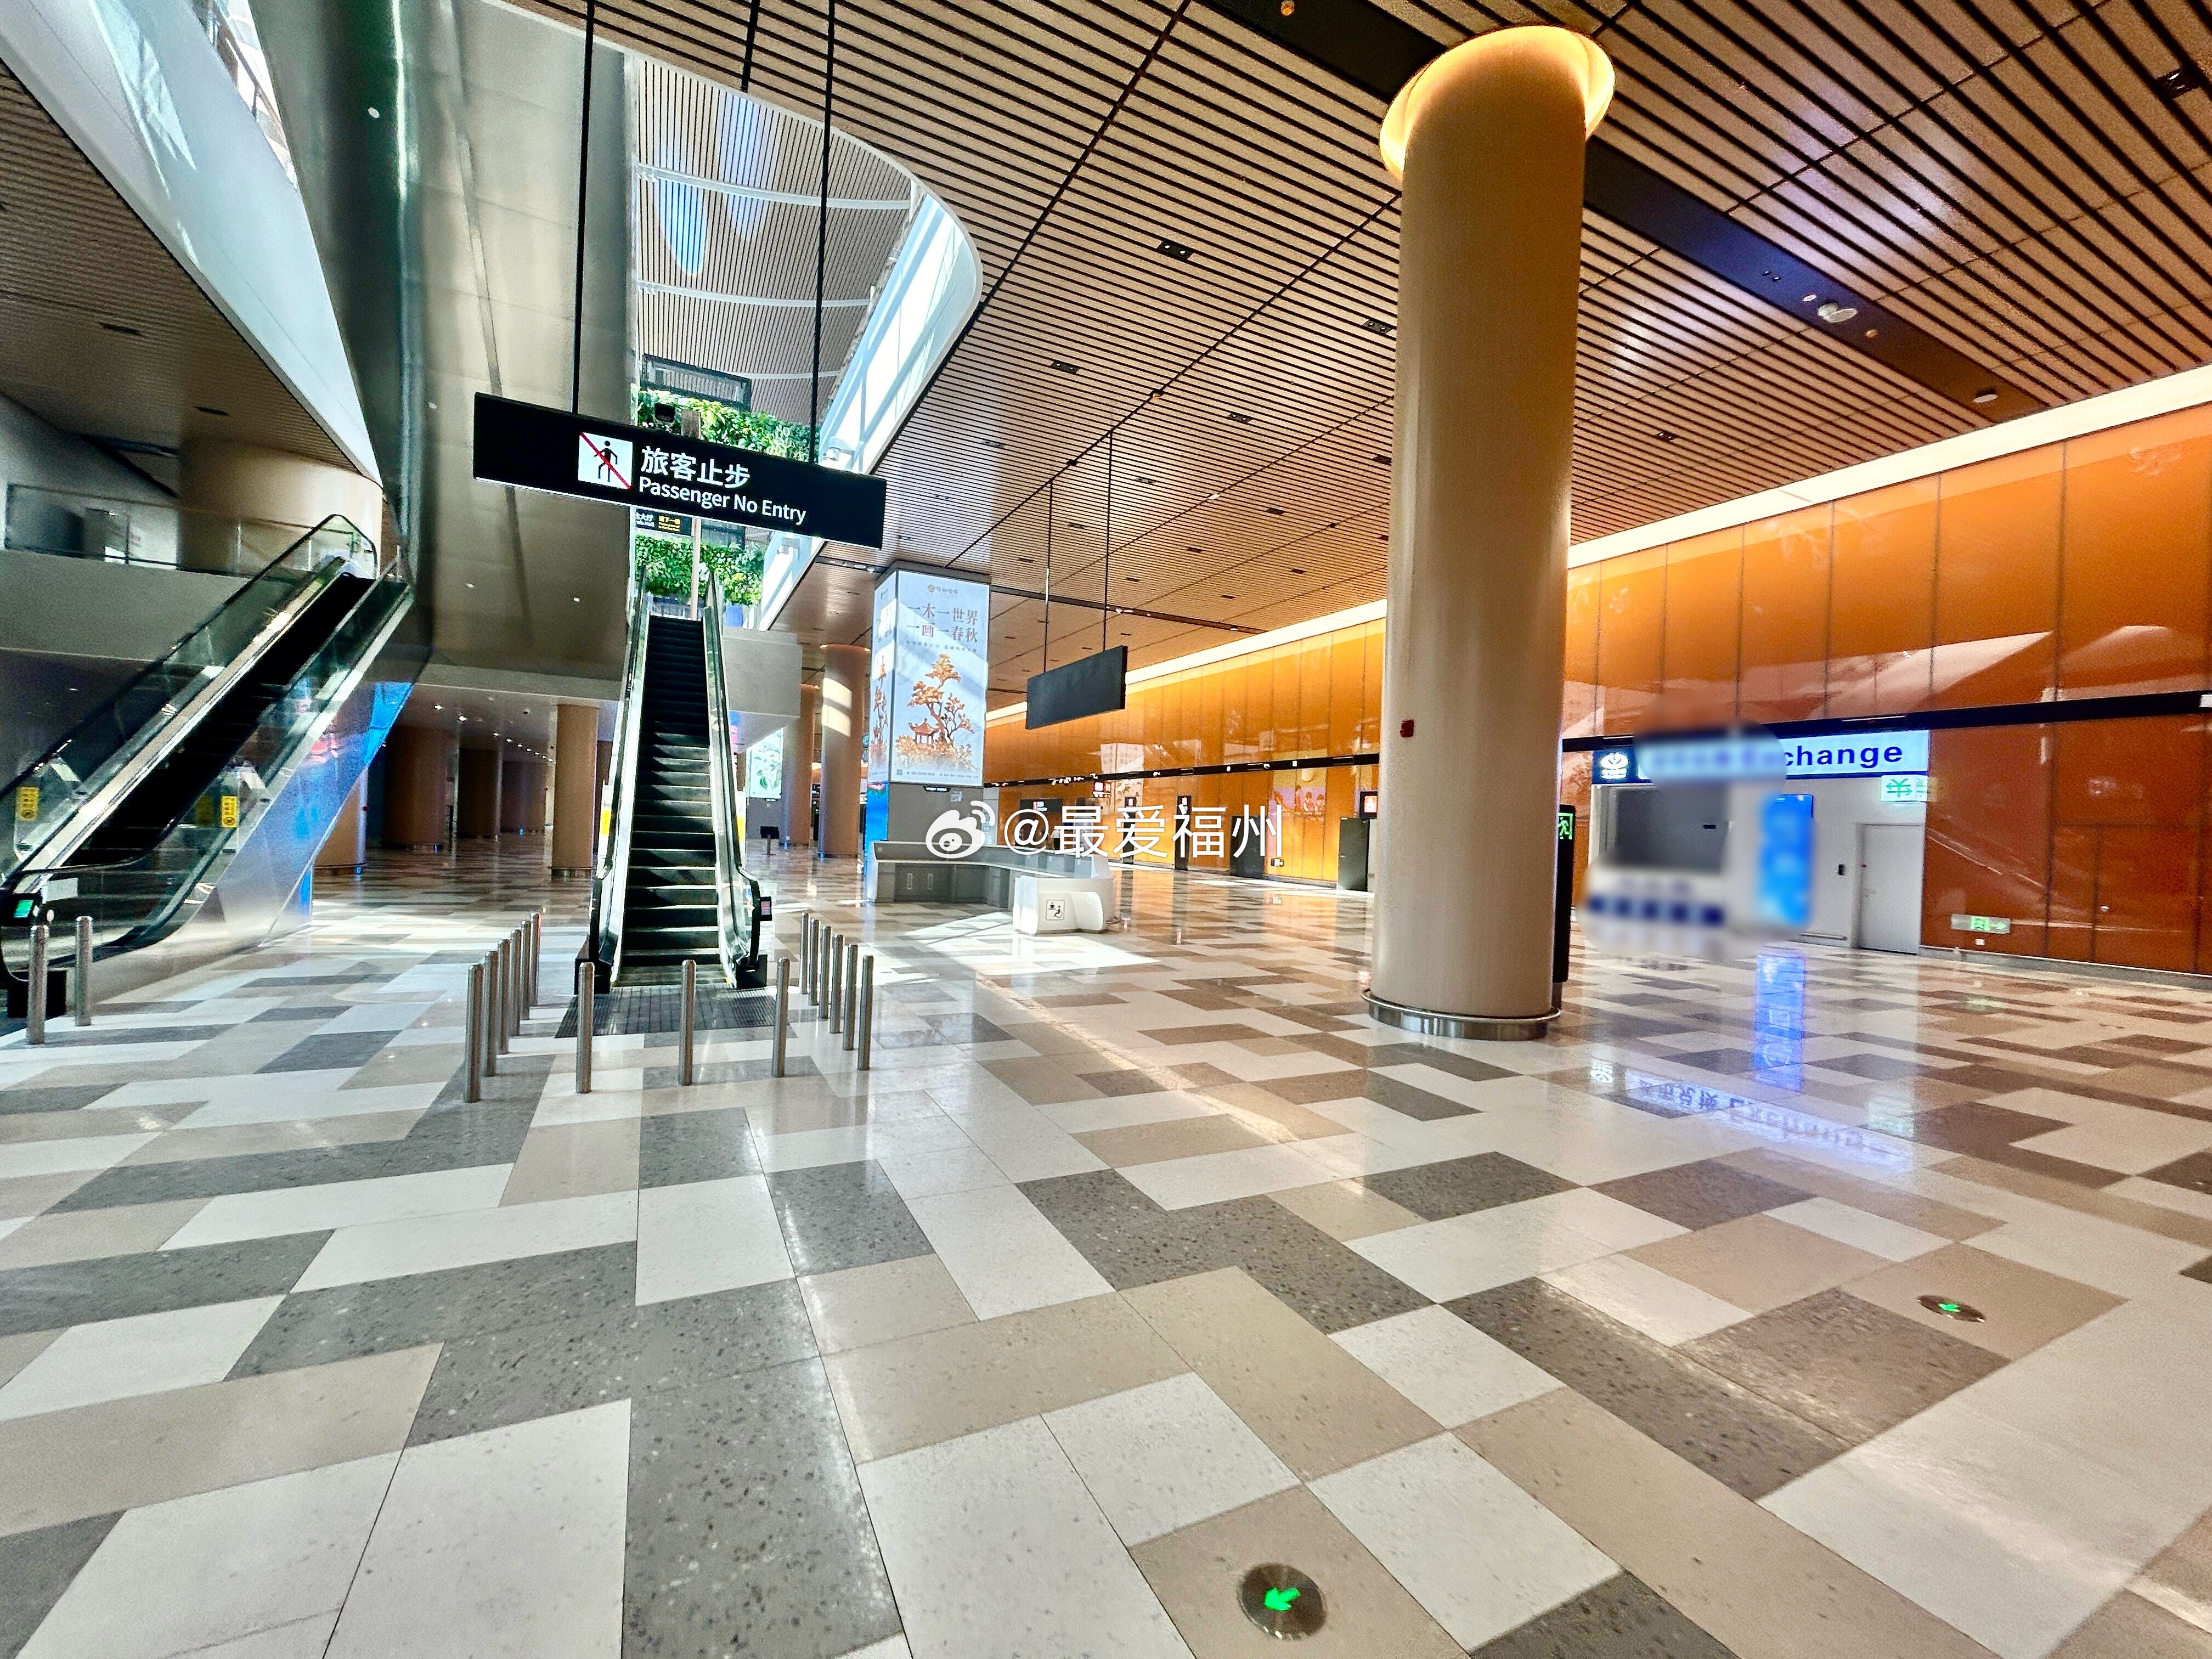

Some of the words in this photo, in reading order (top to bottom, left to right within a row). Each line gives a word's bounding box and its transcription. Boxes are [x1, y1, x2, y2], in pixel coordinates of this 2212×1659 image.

[640, 445, 751, 489] 旅客止步
[639, 475, 730, 509] Passenger
[733, 495, 758, 514] No
[761, 499, 807, 525] Entry
[907, 602, 979, 625] 一木一世界
[906, 622, 979, 643] 一画一春秋
[1745, 745, 1903, 769] change
